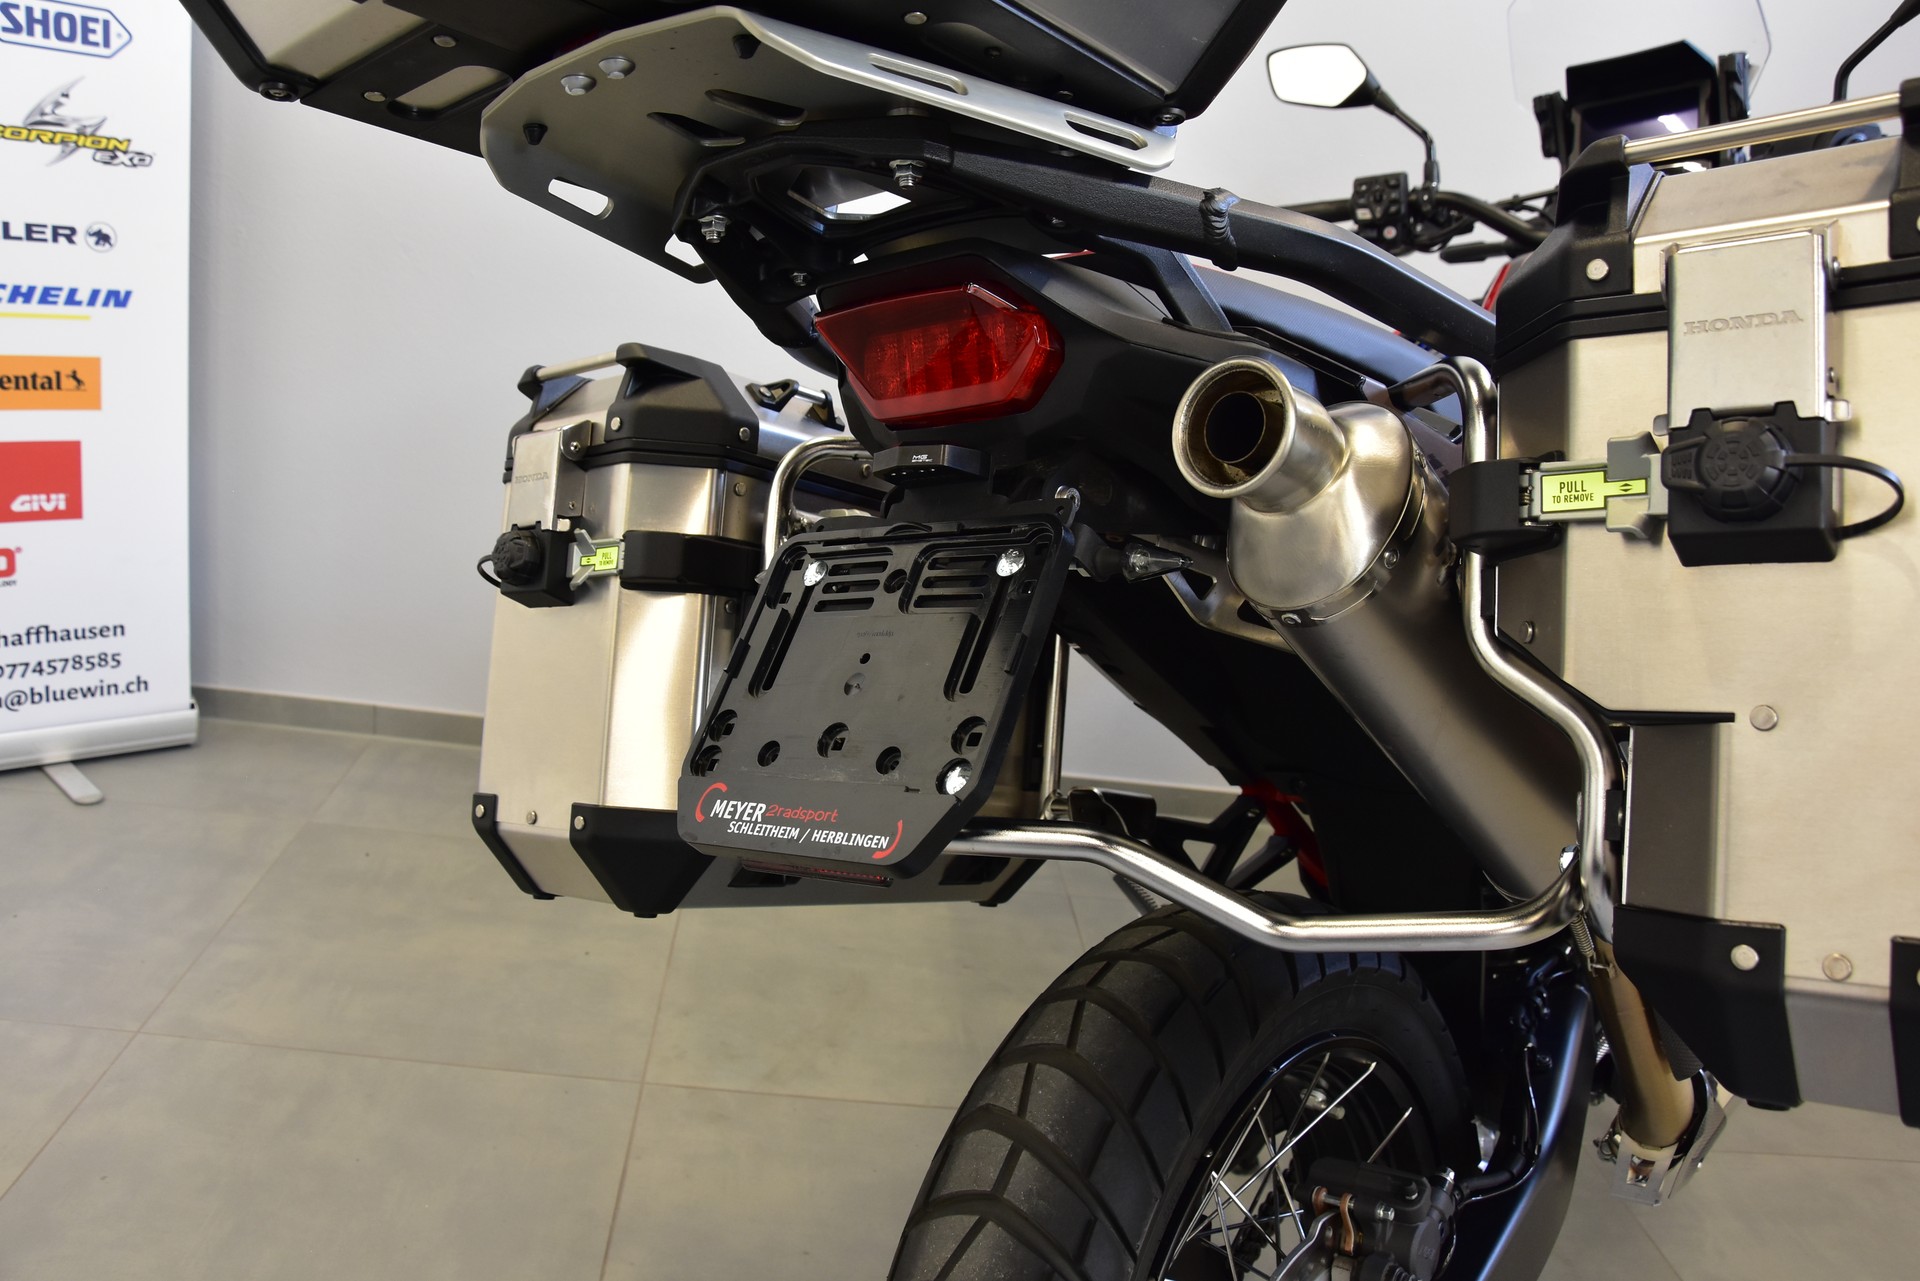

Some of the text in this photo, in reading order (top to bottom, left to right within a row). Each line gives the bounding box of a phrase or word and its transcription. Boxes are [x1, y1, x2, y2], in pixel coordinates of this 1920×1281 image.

[0, 2, 111, 49] SHOEI
[93, 150, 153, 167] EXO
[2, 221, 77, 245] LER
[1683, 309, 1804, 336] HONDA
[0, 371, 62, 391] ental
[515, 472, 549, 484] HONDA
[1559, 480, 1587, 494] PULL
[1552, 492, 1594, 504] TO REMOVE
[601, 552, 612, 560] PULL
[0, 675, 149, 711] @bluewin.ch
[710, 799, 838, 823] MEYER 2radsport
[727, 821, 800, 840] SCHLEITHEIM
[811, 829, 889, 849] HERBLINGEN
